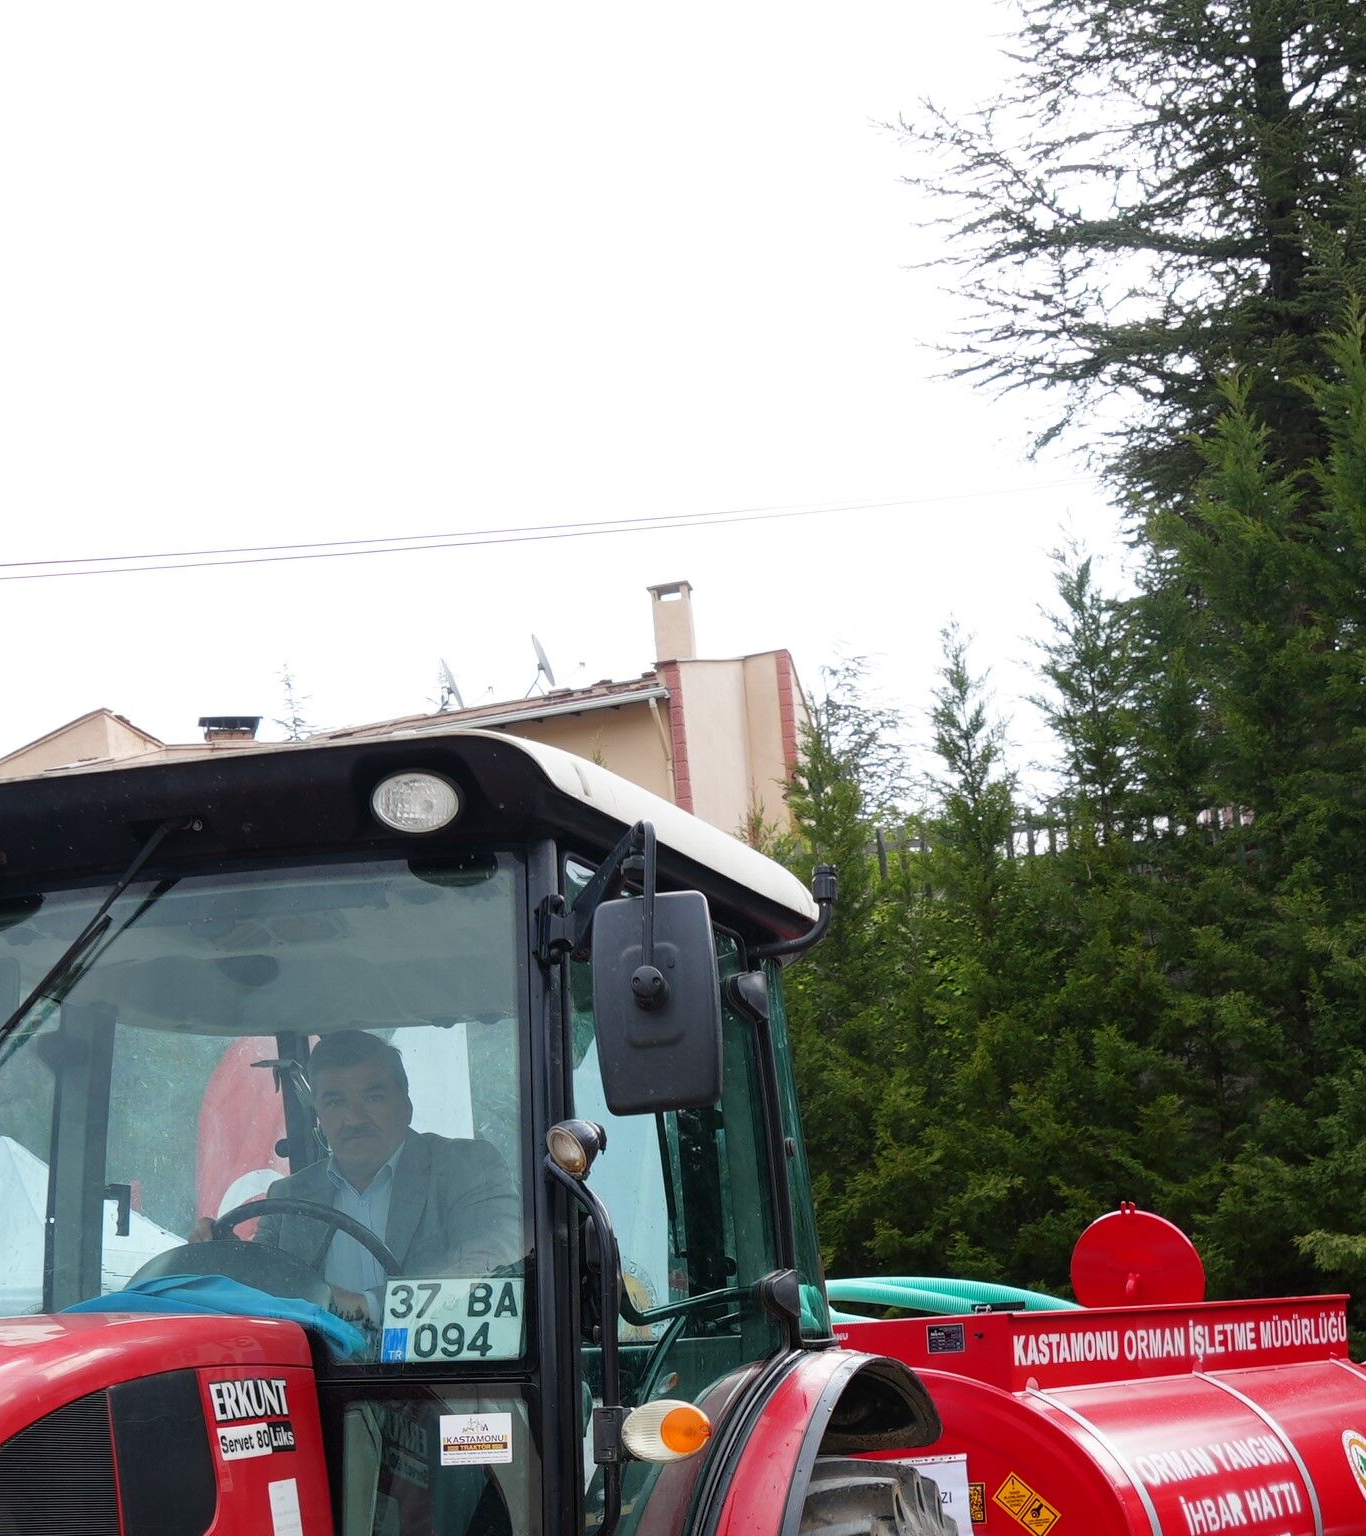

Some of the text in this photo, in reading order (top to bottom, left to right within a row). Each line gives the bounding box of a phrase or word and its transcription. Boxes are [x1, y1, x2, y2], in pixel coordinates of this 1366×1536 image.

[390, 1281, 518, 1318] 37 BA
[388, 1350, 403, 1360] TR
[413, 1321, 492, 1358] 094
[1013, 1310, 1347, 1367] KASTAMONU ORMAN İŞLETME MÜDÜRLÜĞÜ
[208, 1378, 291, 1422] ERKUNT
[220, 1426, 295, 1454] Servet 80 Lüks
[446, 1434, 504, 1444] KASTAMONU
[1135, 1434, 1289, 1488] ORMAN YANGIN
[1179, 1482, 1302, 1536] İHBAR HATTI
